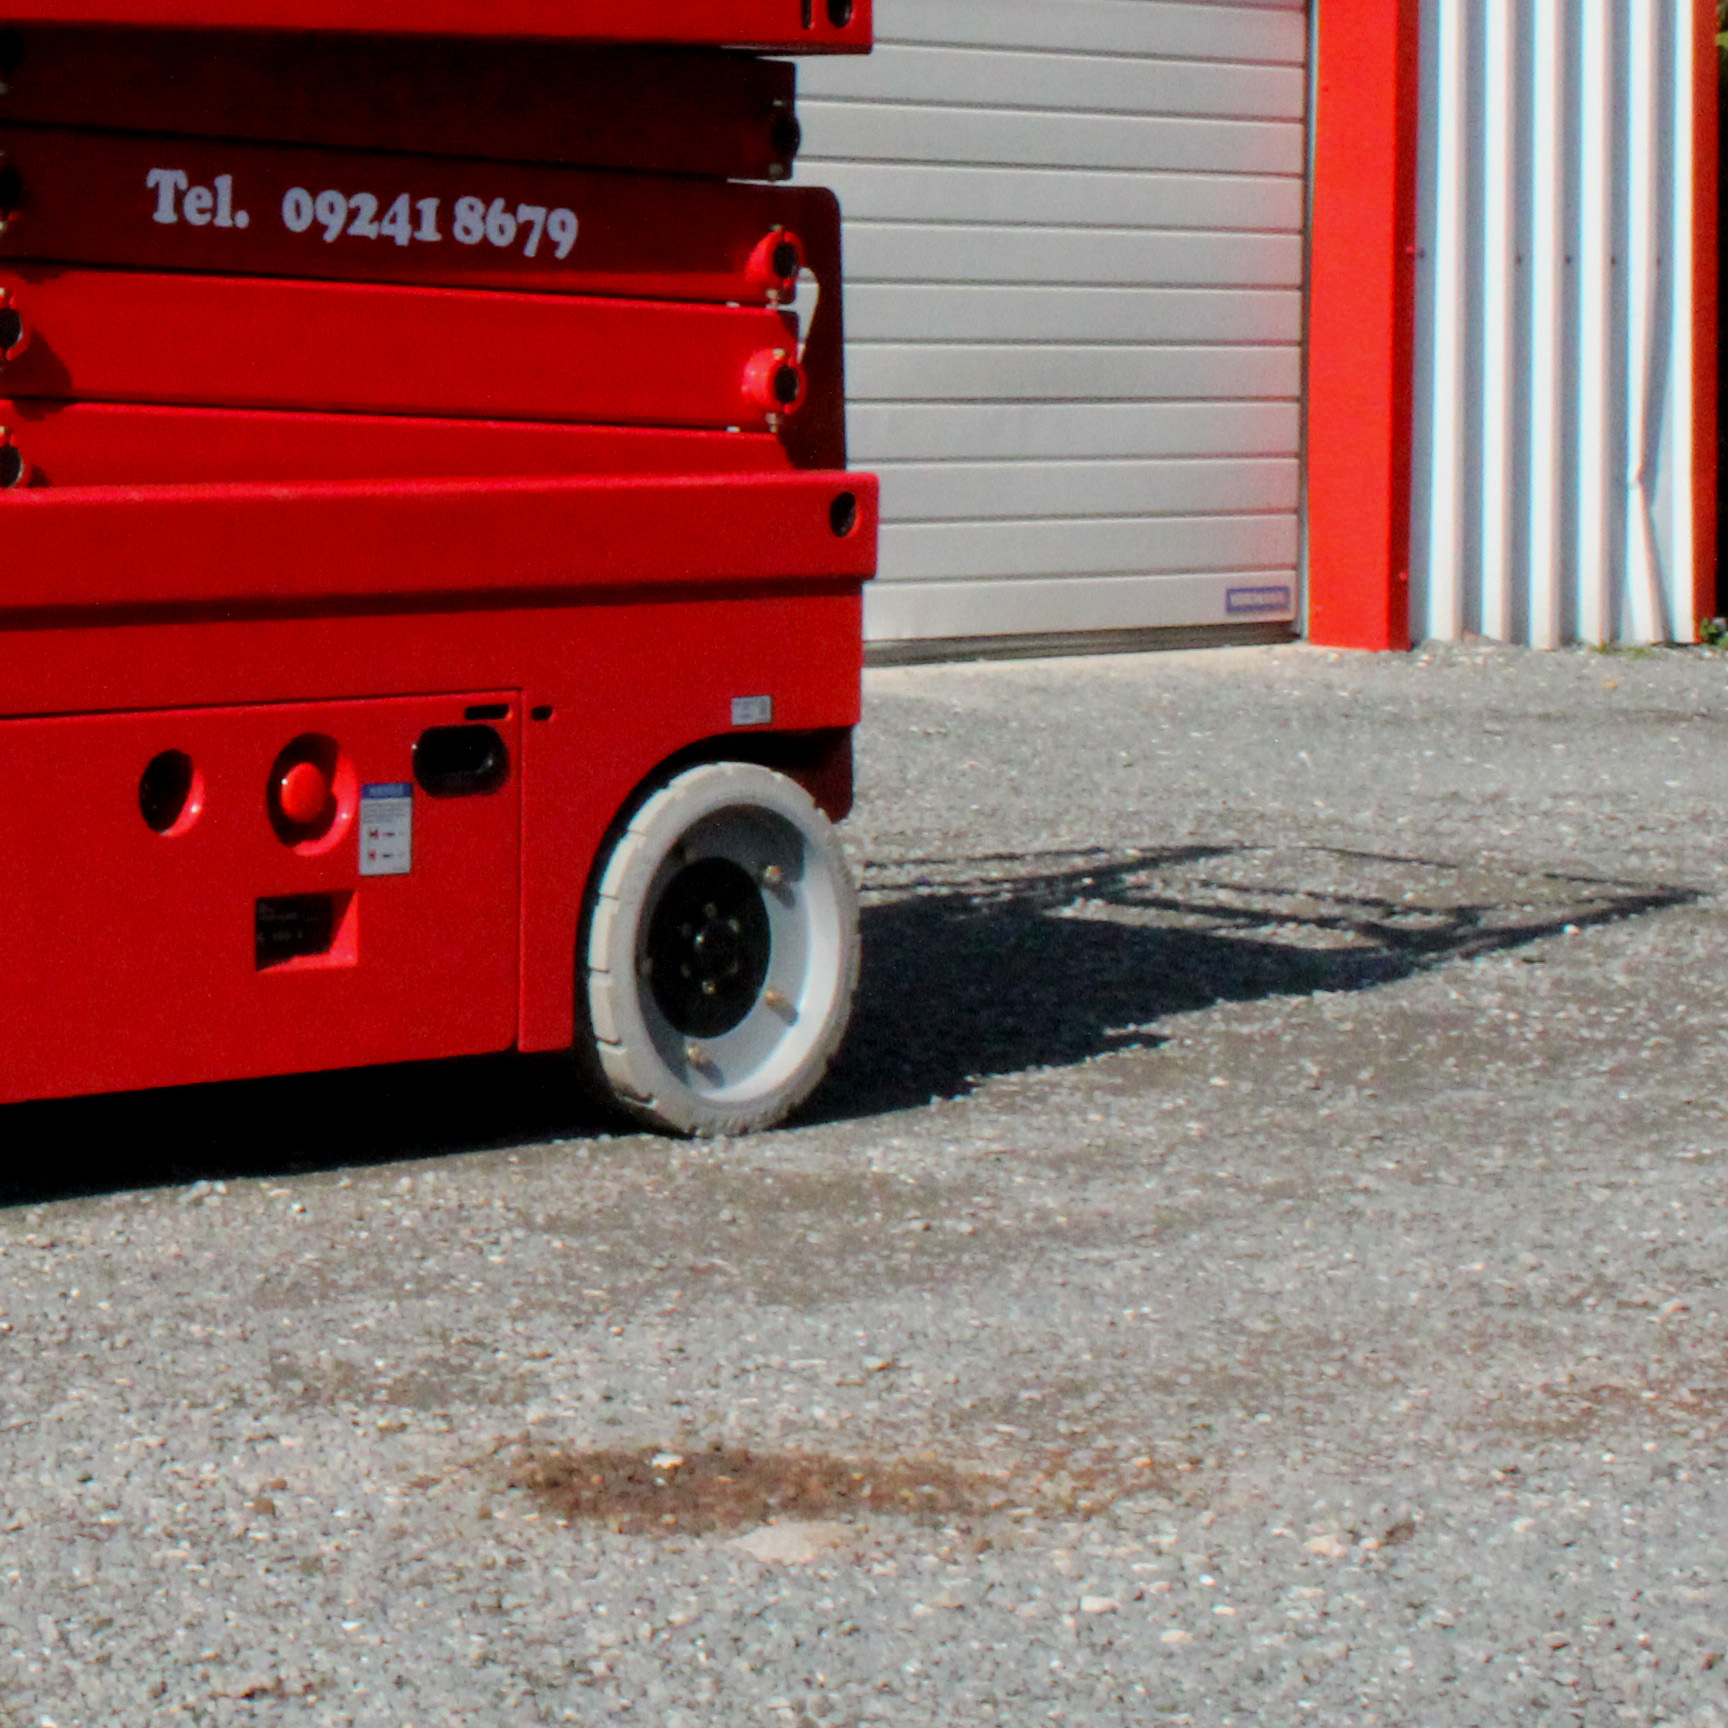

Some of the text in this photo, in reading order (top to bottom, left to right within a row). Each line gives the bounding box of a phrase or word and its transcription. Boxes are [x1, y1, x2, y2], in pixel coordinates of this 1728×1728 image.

[146, 167, 580, 260] Tel. 09241 8679
